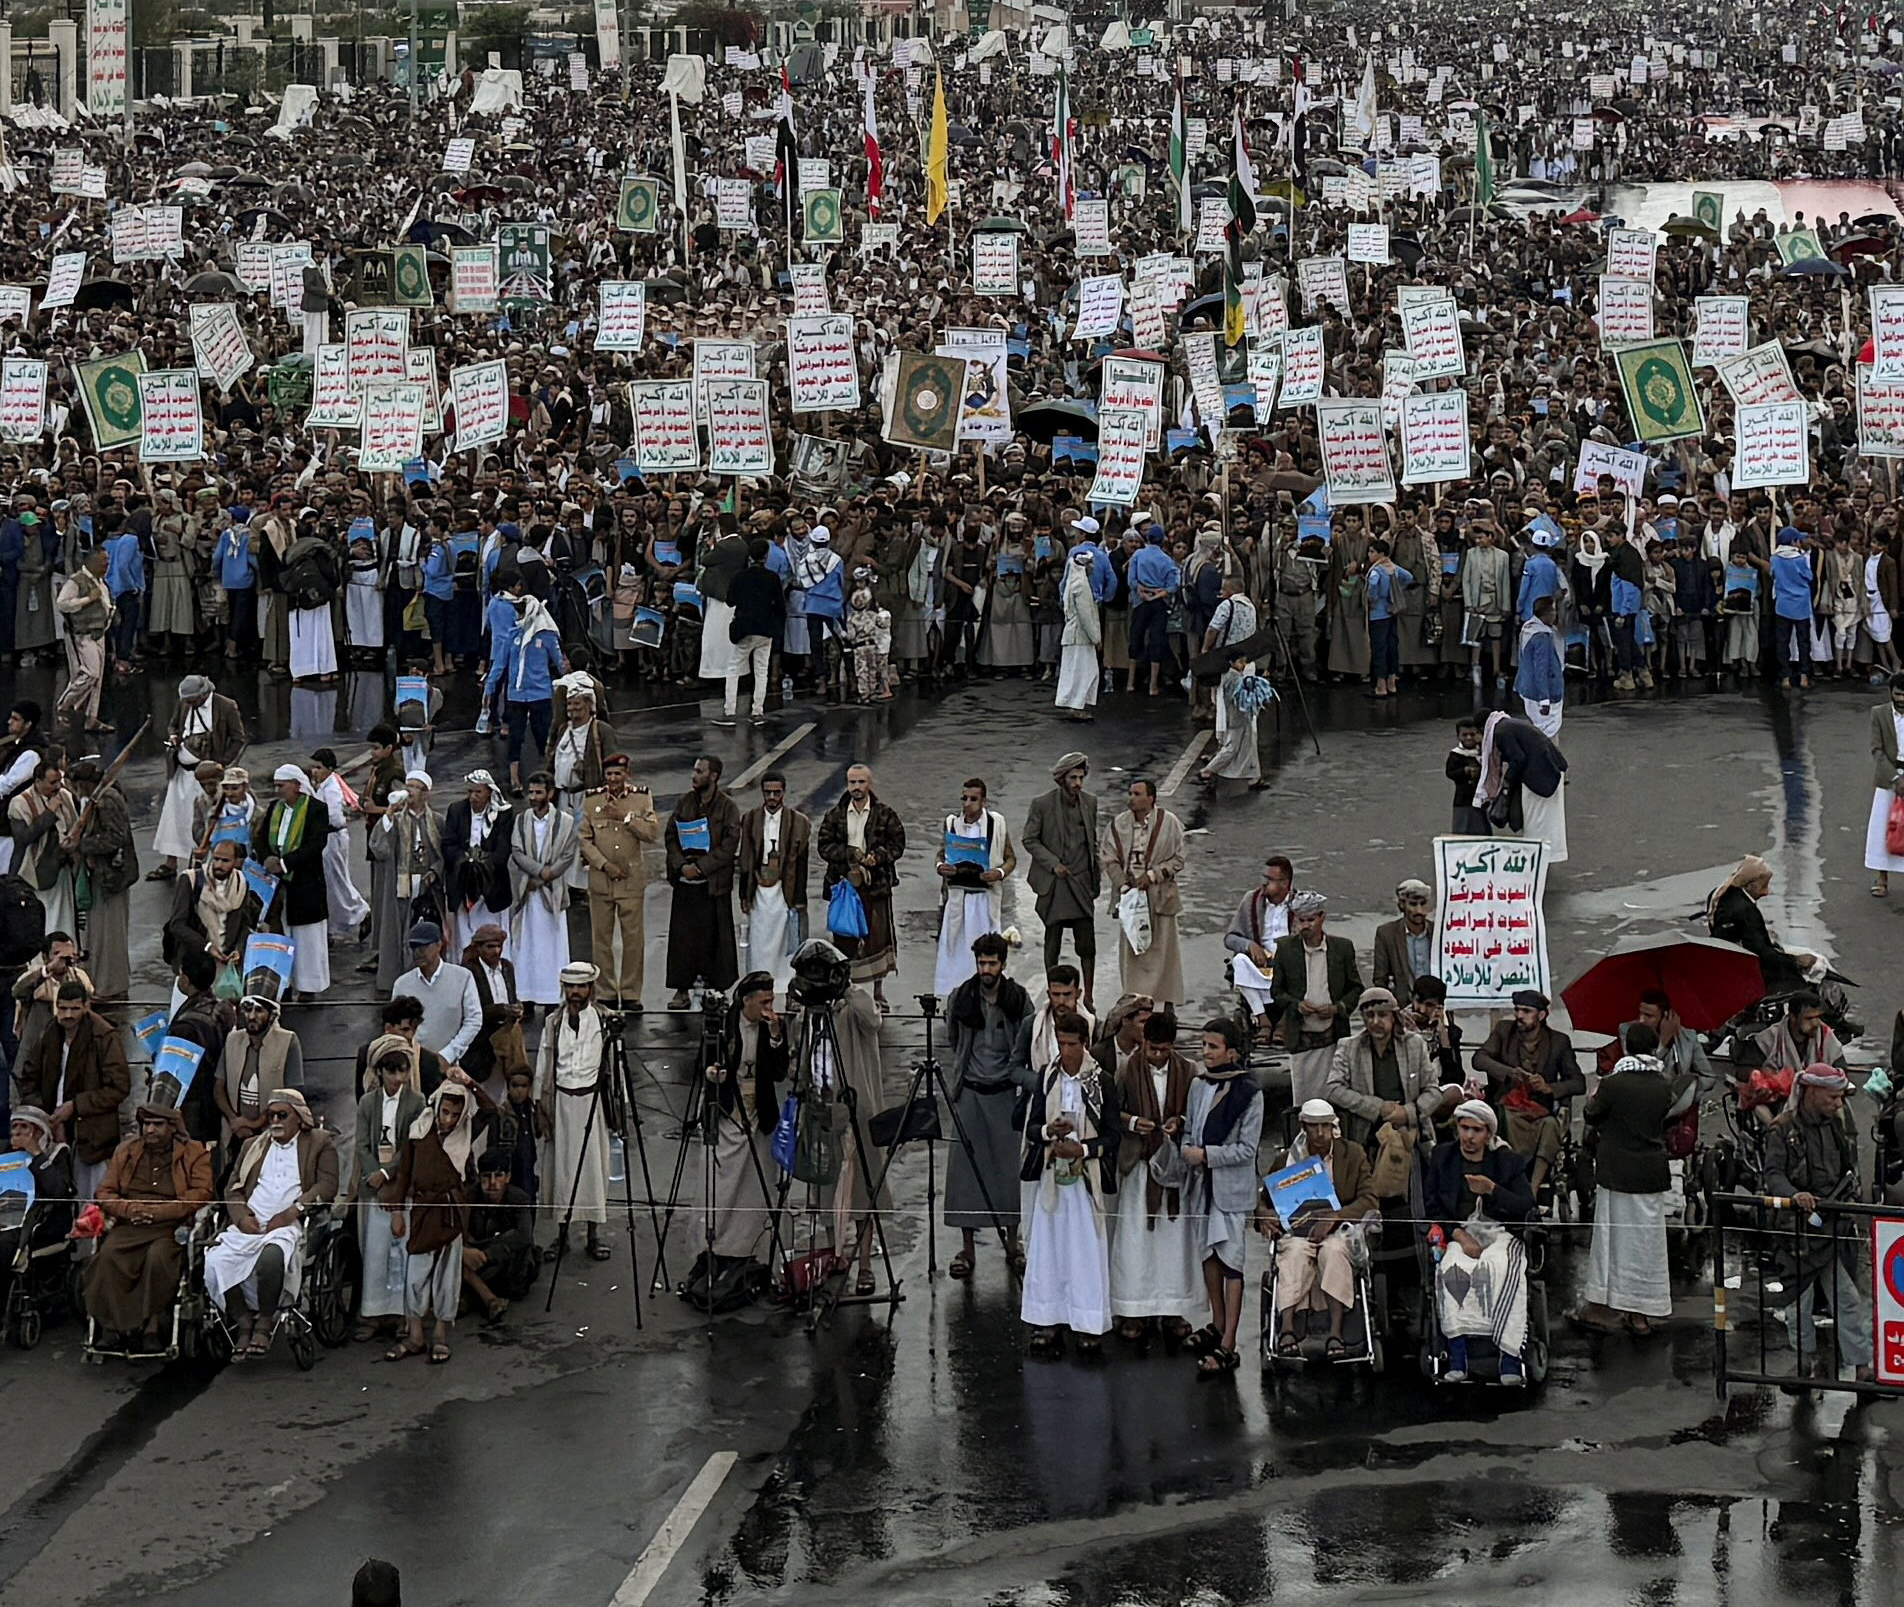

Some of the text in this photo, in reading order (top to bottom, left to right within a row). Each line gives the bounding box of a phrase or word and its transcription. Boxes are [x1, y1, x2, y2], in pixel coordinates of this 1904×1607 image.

[1450, 845, 1535, 883] الله أكبر
[1449, 881, 1531, 904] الموت لأمريكا
[1498, 911, 1531, 928] الموت
[1444, 937, 1533, 959] اللعنة على اليهود
[1445, 962, 1536, 993] النصر للإسلام
